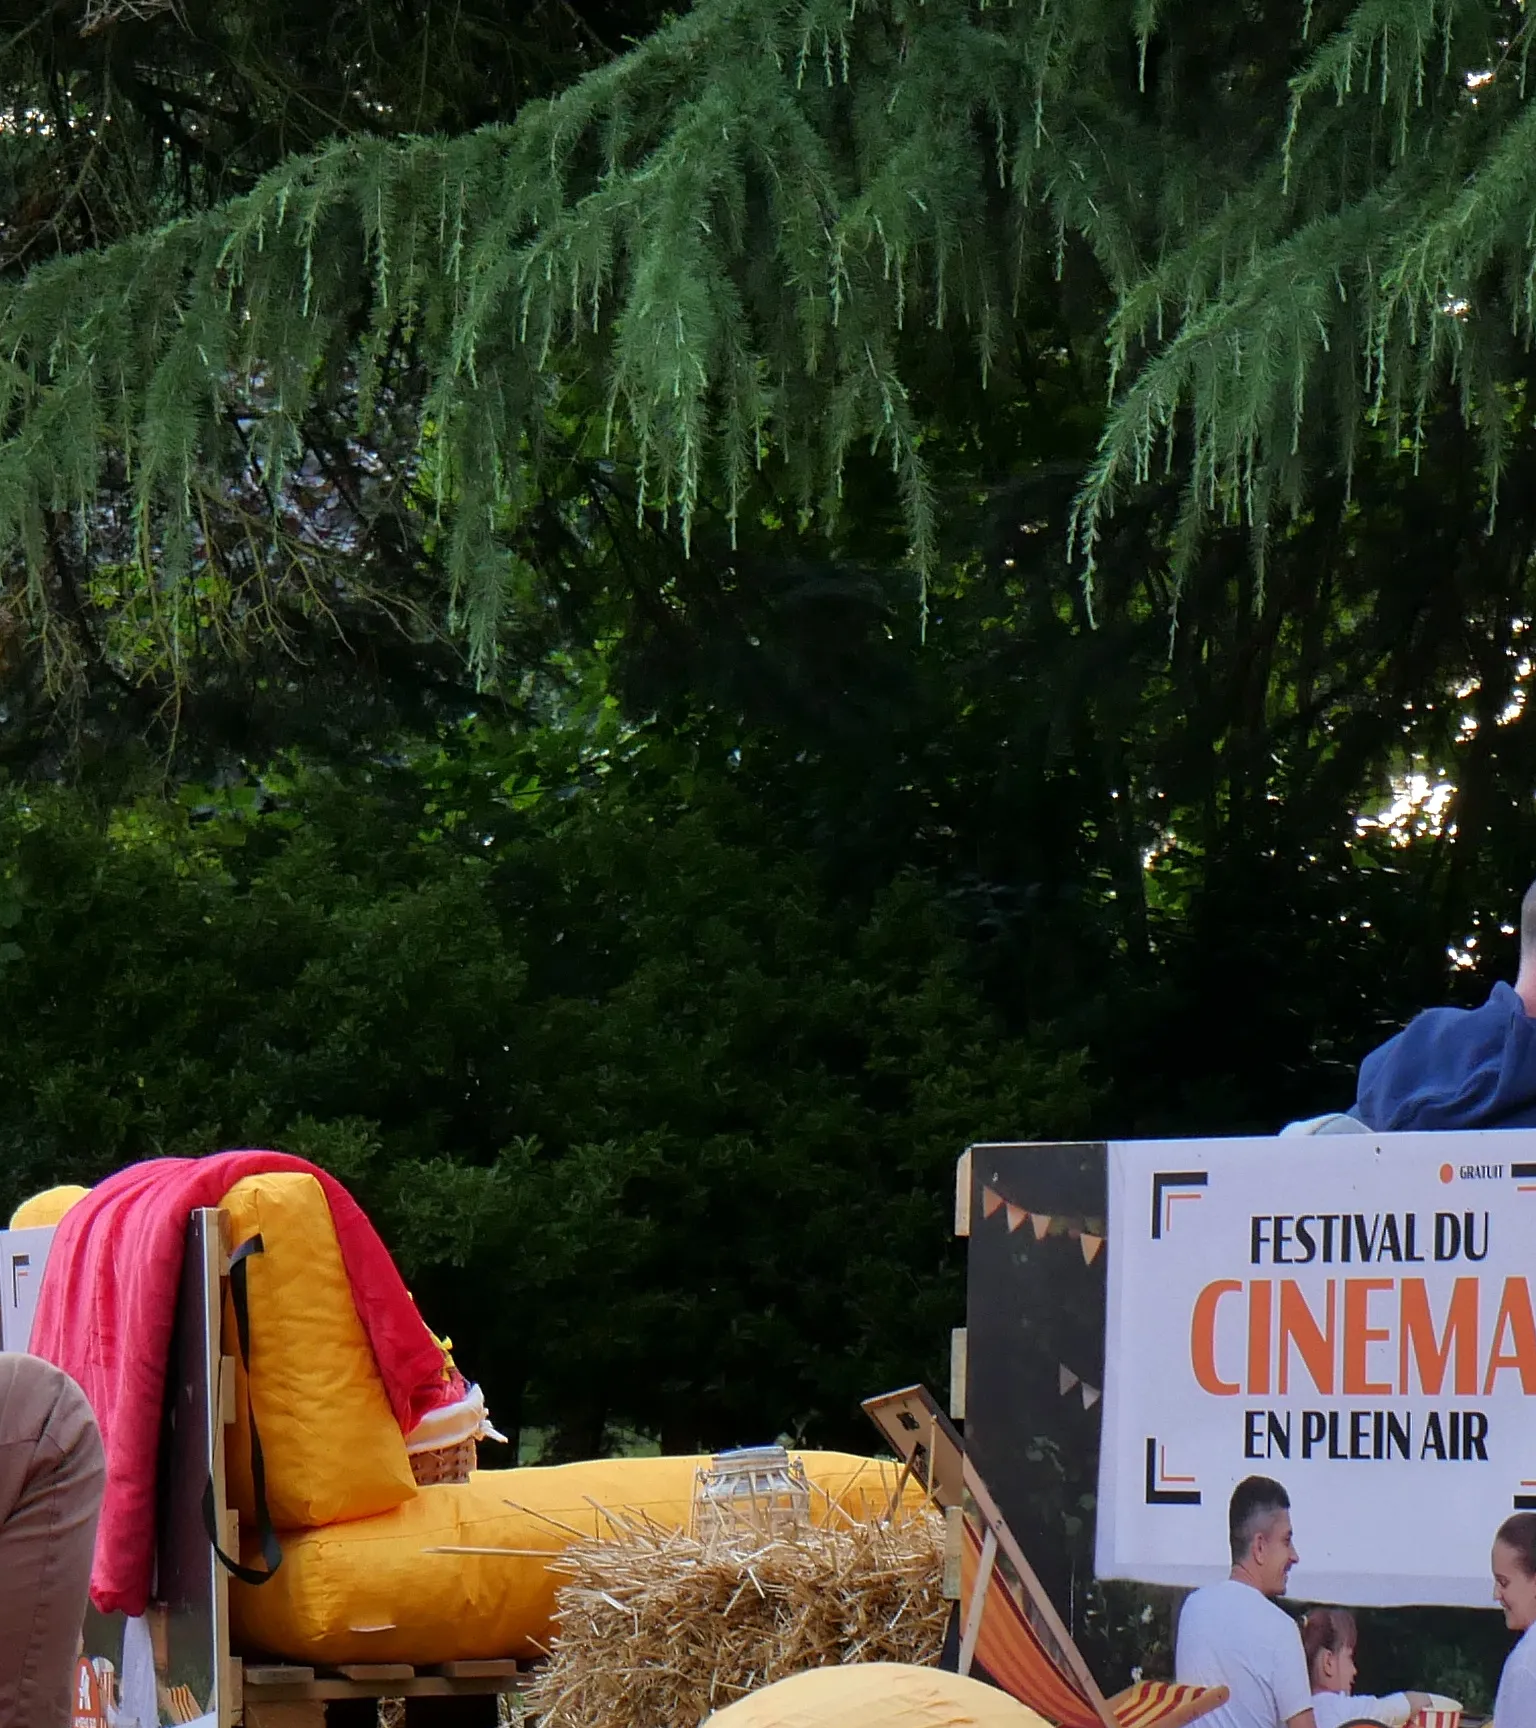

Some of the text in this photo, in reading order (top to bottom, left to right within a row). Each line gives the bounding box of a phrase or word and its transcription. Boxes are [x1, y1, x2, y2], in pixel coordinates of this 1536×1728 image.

[1460, 1164, 1504, 1180] GRATUIT
[1250, 1211, 1489, 1264] FESTIVAL DU
[1244, 1409, 1489, 1461] EN PLEIN AIR
